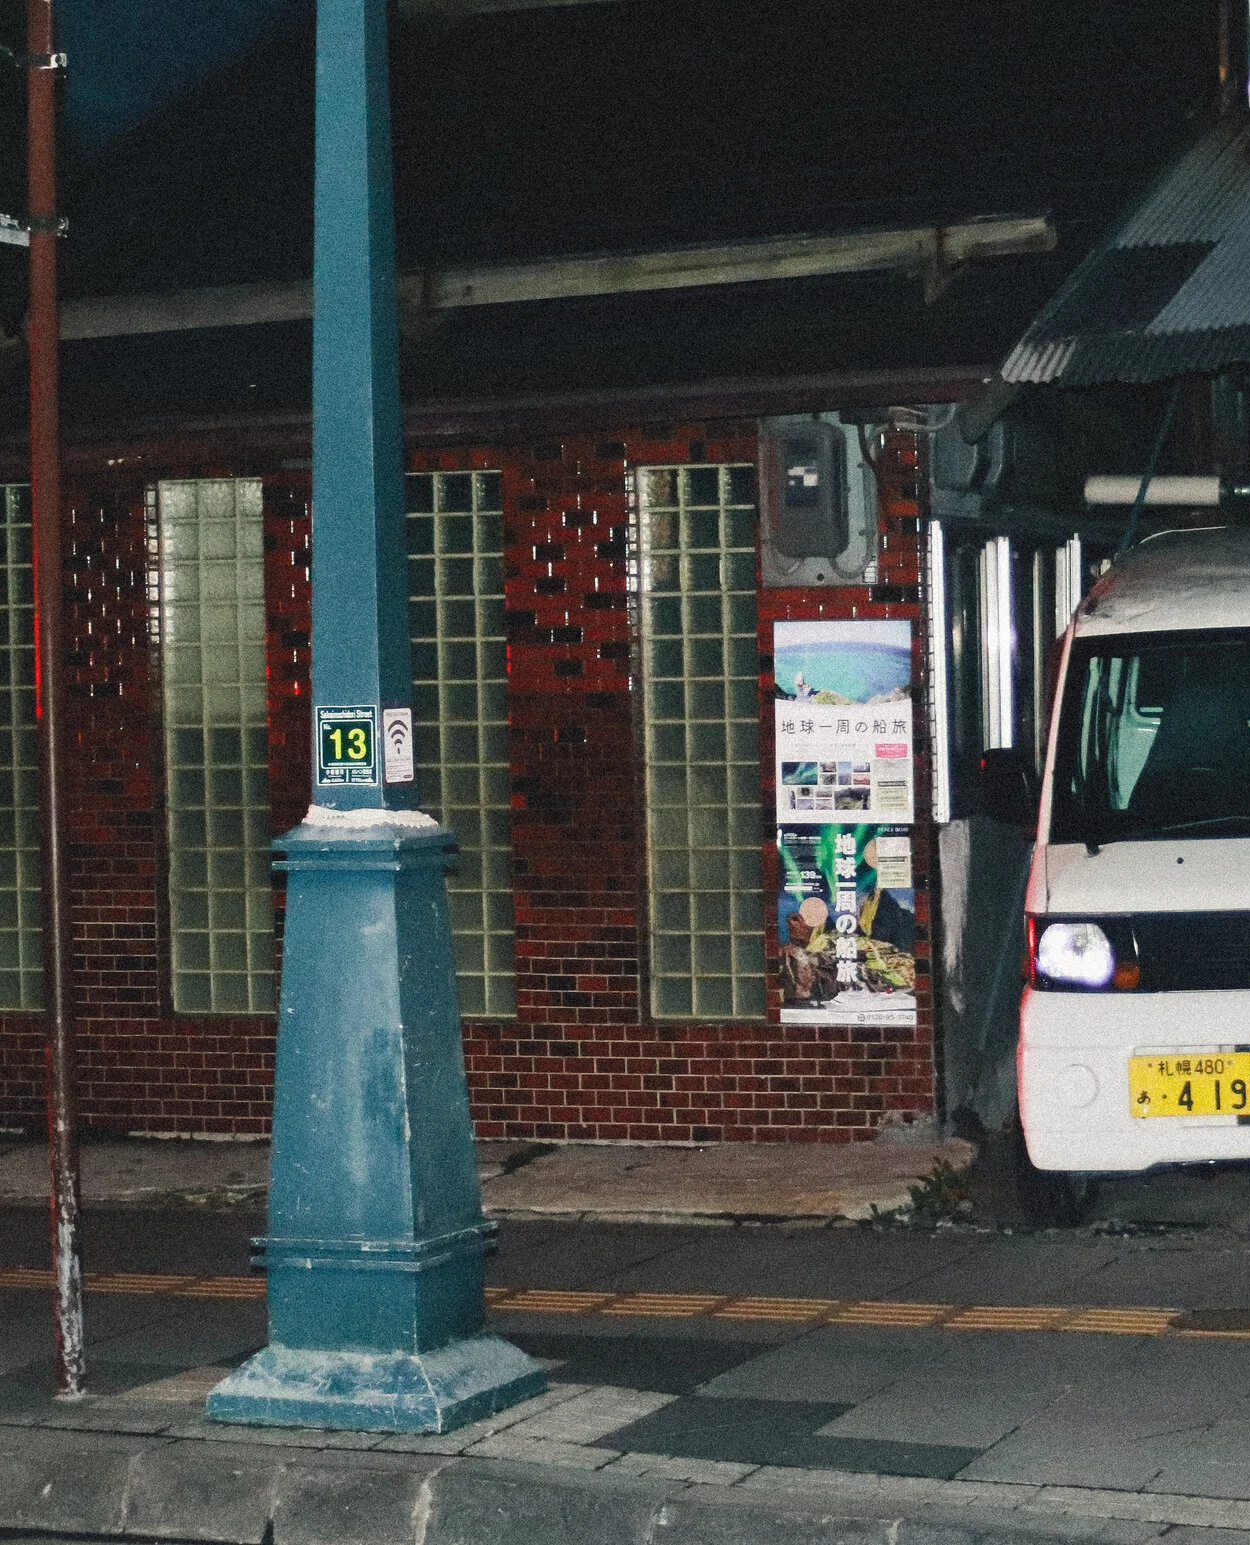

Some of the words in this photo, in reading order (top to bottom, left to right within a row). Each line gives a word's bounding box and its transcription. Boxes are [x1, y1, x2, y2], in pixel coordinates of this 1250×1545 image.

[781, 719, 907, 734] 地球一周の船旅
[329, 728, 367, 760] 13
[834, 833, 858, 983] 地球一周の船旅
[1158, 1060, 1192, 1076] 札幌
[1195, 1059, 1224, 1075] 480
[1136, 1090, 1150, 1105] あ
